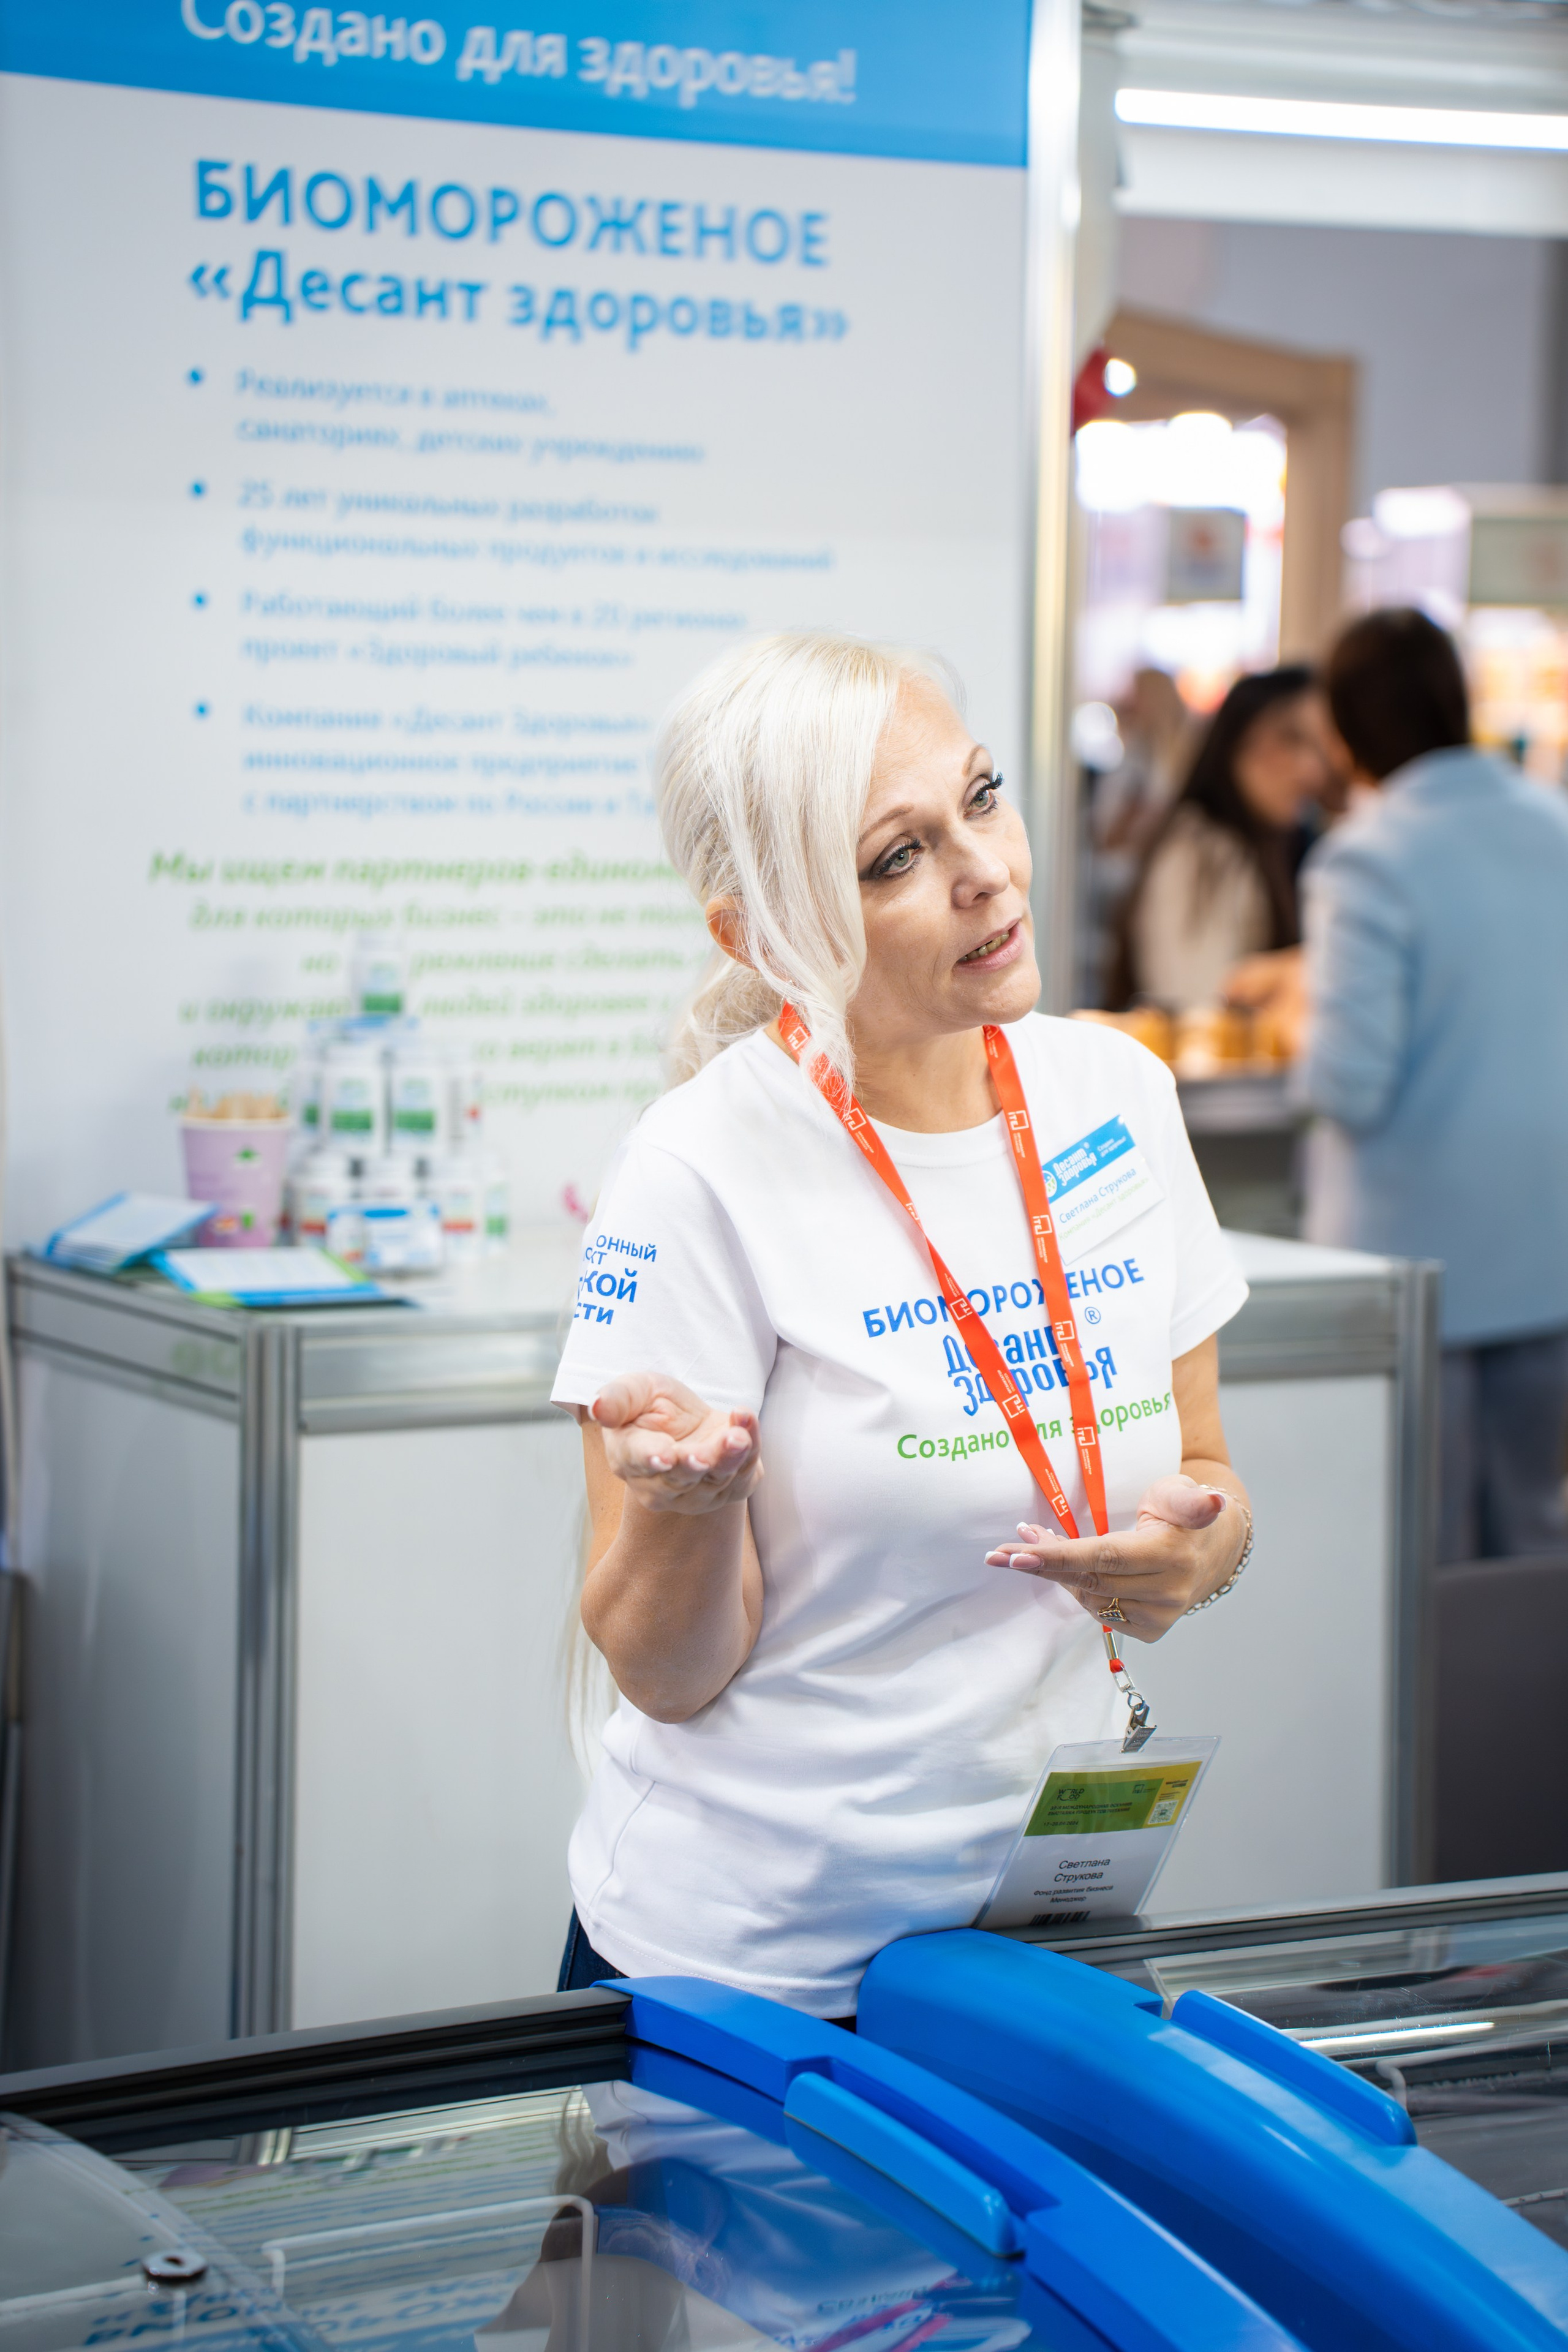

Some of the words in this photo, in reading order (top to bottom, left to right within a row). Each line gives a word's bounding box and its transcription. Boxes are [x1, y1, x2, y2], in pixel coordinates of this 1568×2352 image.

[181, 0, 447, 66] Создано
[455, 25, 567, 85] для
[578, 36, 857, 109] здоровья!
[194, 157, 831, 268] БИОМОРОЖЕНОЕ
[186, 247, 493, 325] «Десант
[507, 283, 851, 354] здоровья»
[1052, 1147, 1088, 1176] Десант
[1059, 1194, 1099, 1224] Светлана
[1098, 1168, 1137, 1198] Струкова
[897, 1430, 1010, 1461] Создано
[1035, 1419, 1063, 1441] ля
[1054, 1871, 1104, 1883] Струкова
[1058, 1858, 1111, 1869] Светлана
